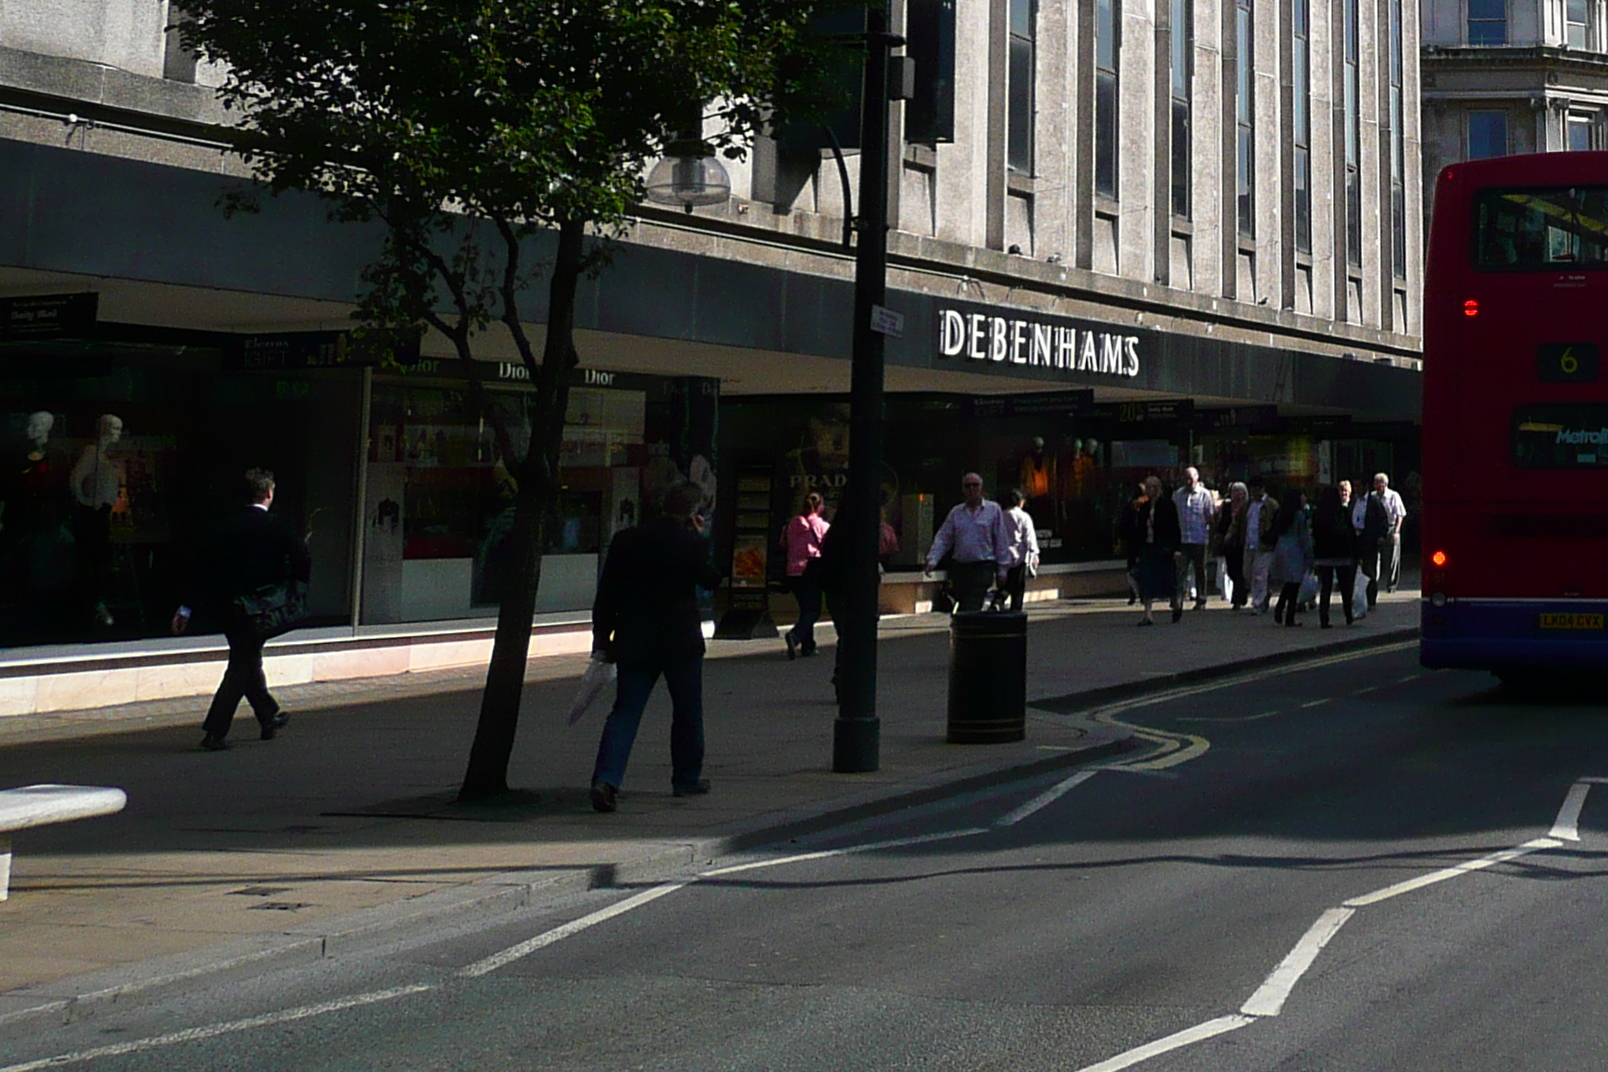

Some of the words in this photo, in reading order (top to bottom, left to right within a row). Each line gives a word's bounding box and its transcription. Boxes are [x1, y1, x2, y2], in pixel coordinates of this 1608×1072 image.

[940, 309, 1140, 377] DEBENHAMS
[1560, 346, 1579, 374] 6
[584, 369, 616, 385] Dior
[789, 474, 849, 489] PRAD
[1544, 615, 1574, 627] LK04
